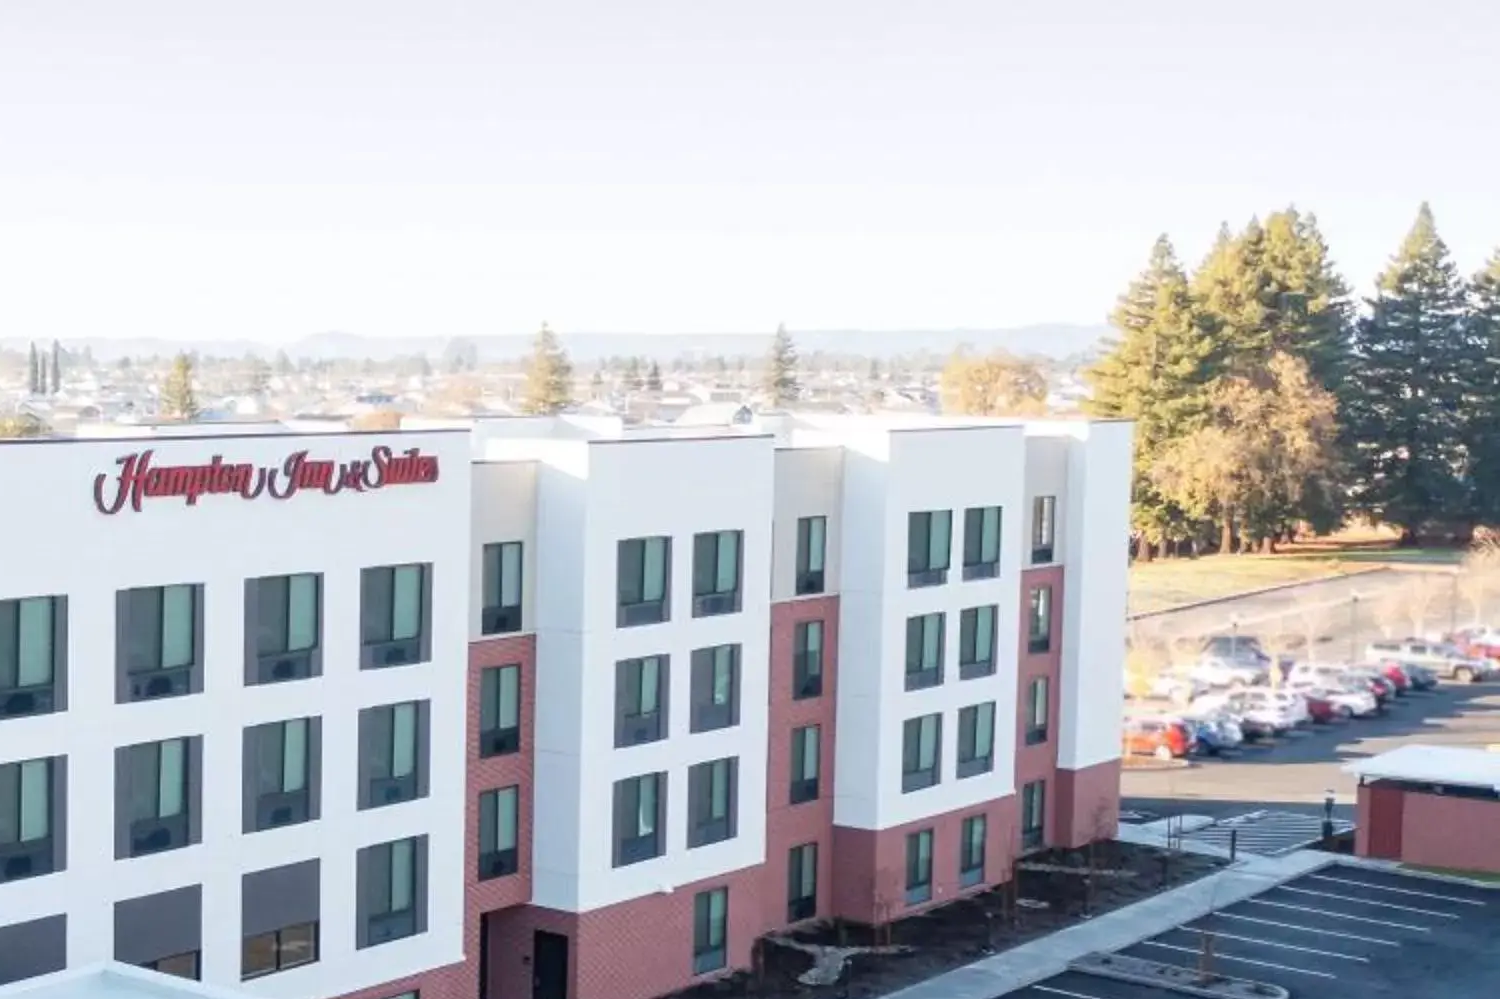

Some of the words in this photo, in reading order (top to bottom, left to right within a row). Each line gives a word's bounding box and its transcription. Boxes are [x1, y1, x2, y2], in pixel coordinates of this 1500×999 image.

[94, 449, 266, 514] Hampton
[268, 449, 349, 500] Inn
[343, 456, 367, 493] &
[363, 445, 439, 489] Suites
